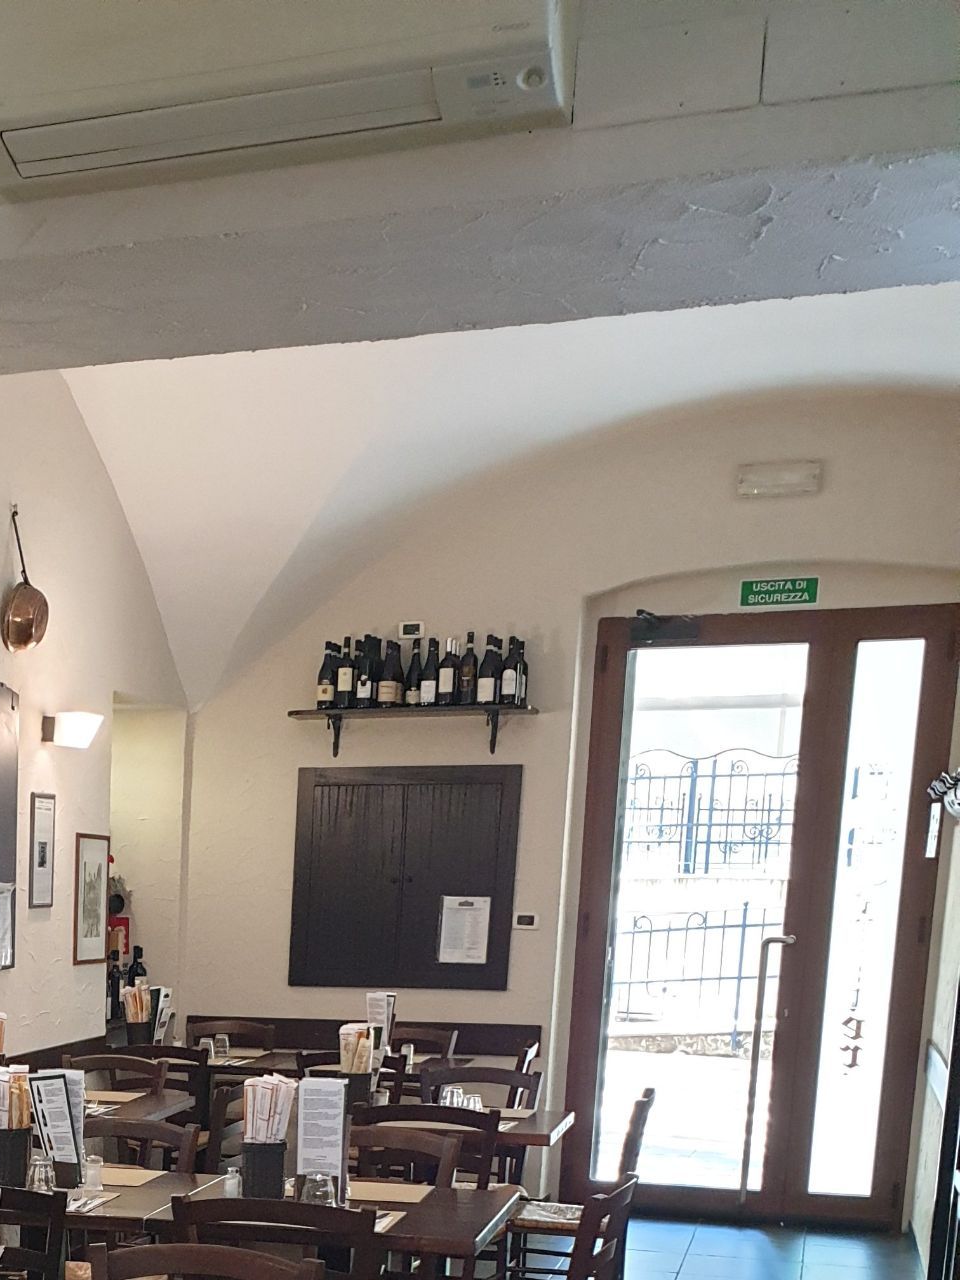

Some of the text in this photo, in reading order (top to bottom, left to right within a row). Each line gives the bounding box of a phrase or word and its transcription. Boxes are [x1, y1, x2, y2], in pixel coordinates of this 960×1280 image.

[752, 580, 807, 591] USCITA DI
[748, 592, 809, 603] SICUREZZA
